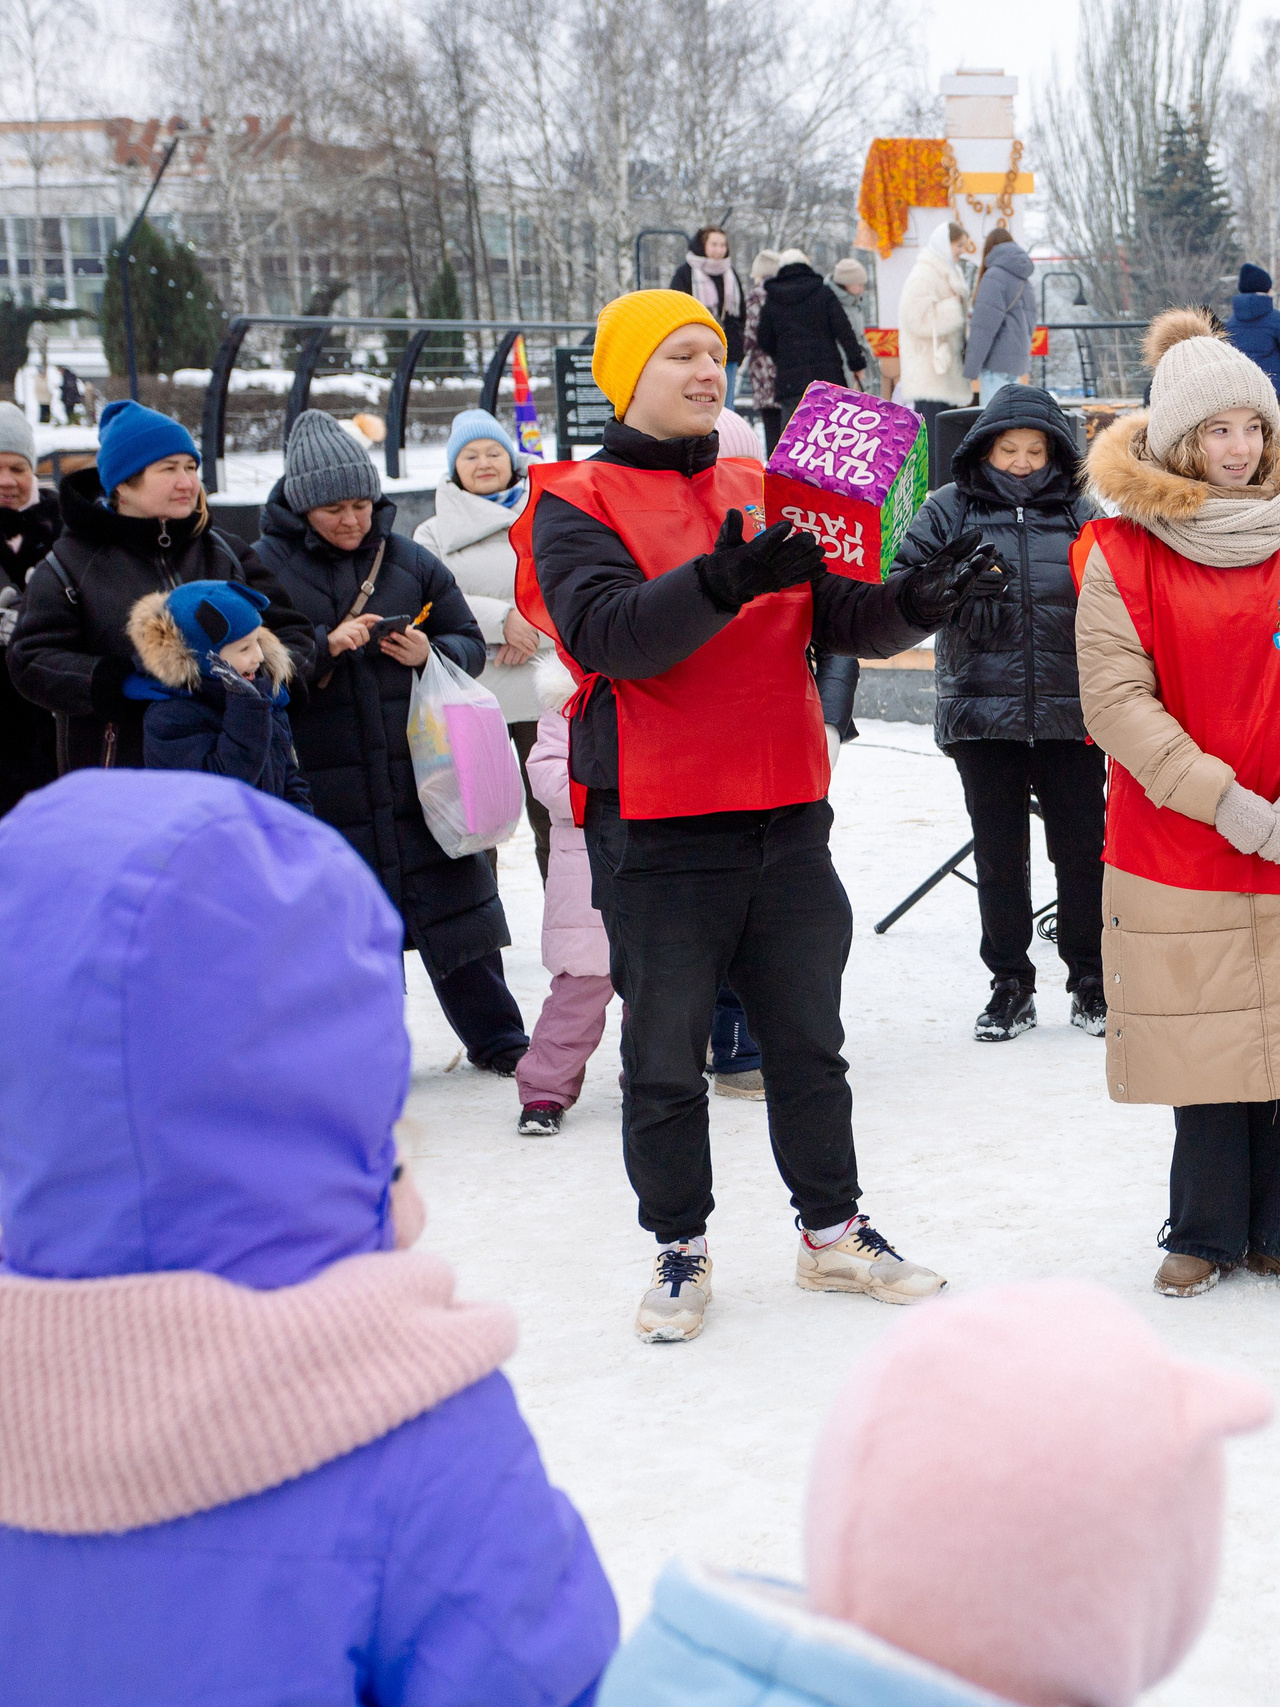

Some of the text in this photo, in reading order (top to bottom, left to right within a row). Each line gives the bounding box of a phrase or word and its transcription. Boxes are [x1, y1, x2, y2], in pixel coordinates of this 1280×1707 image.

[829, 401, 882, 431] ПО
[806, 419, 882, 462] КРИ
[788, 441, 875, 486] ЧАТЬ
[781, 505, 864, 546] ГАТЬ
